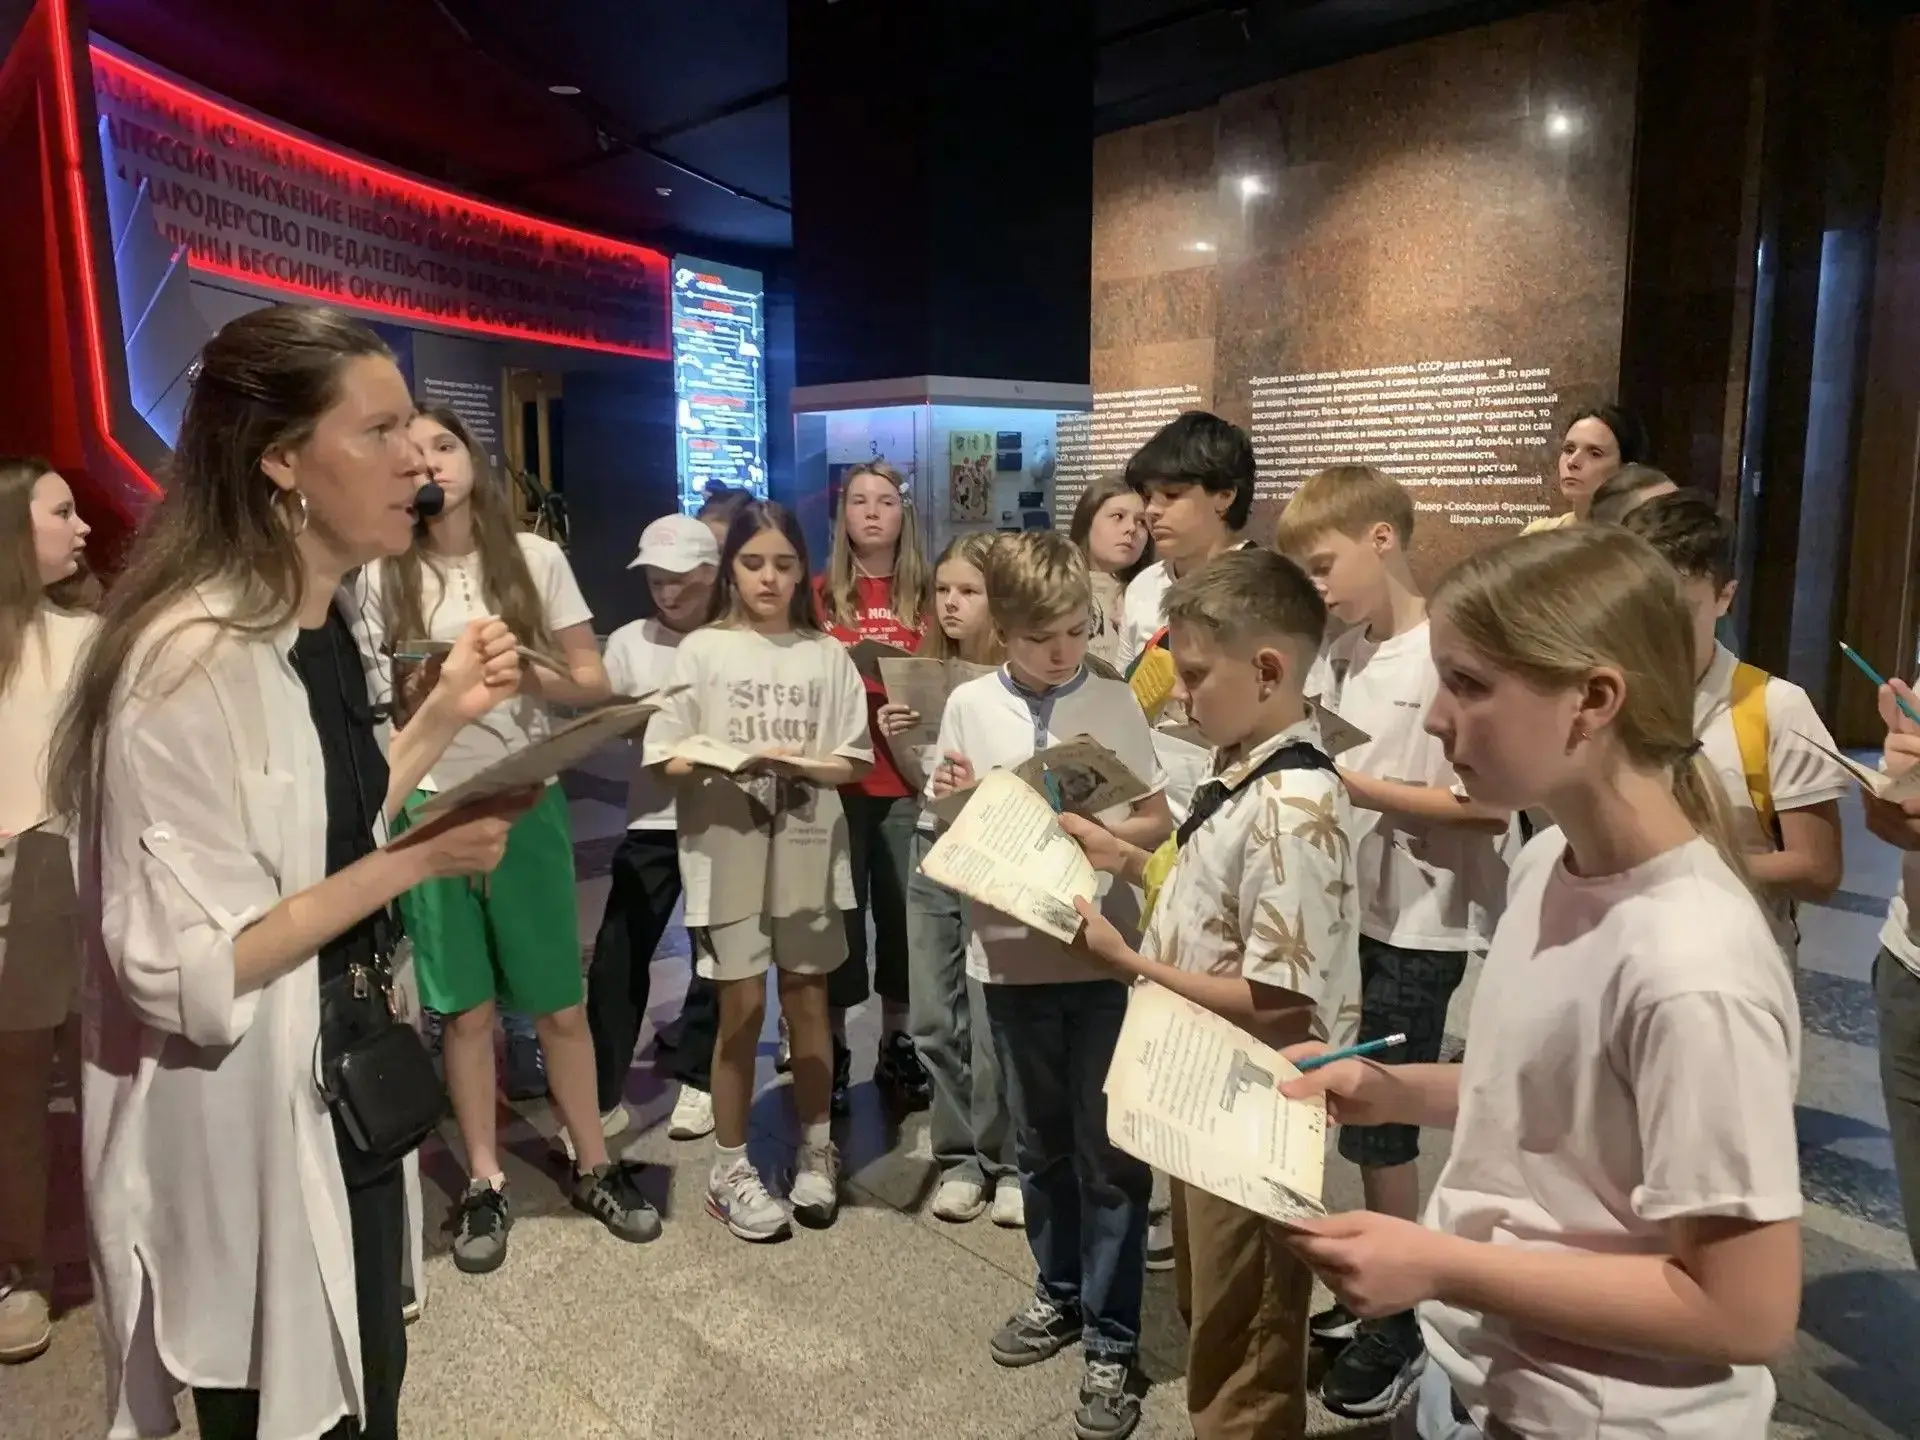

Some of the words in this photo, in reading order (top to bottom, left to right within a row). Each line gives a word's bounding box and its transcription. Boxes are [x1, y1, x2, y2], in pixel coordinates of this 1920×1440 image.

[221, 157, 343, 225] УНИЖЕНИЕ
[135, 168, 301, 249] МАРОДЕРСТВО
[306, 225, 464, 289] ПРЕДАТЕЛЬСТВО
[238, 243, 344, 296] БЕССИЛИЕ
[1280, 374, 1294, 382] всю
[1296, 373, 1315, 381] свою
[1316, 371, 1339, 379] мощь
[1340, 368, 1369, 378] против
[1370, 365, 1416, 375] агрессора,
[1417, 360, 1442, 371] СССР
[1443, 361, 1460, 370] дал
[1461, 359, 1484, 367] всем
[1486, 357, 1511, 366] ныне
[1298, 383, 1331, 393] народам
[1332, 380, 1384, 392] уверенность
[1419, 373, 1489, 384] освобождении.
[1519, 367, 1549, 377] время
[1288, 396, 1325, 406] Германии
[1343, 393, 1378, 403] престиж
[1379, 388, 1440, 399] поколеблены,
[1442, 386, 1474, 395] солнце
[1476, 381, 1513, 394] русской
[1515, 381, 1545, 390] славы
[1321, 406, 1339, 415] Весь
[1340, 406, 1357, 415] мир
[1359, 403, 1407, 414] убеждается
[1435, 400, 1451, 408] что
[1453, 399, 1472, 407] этот
[1474, 393, 1557, 406] 175-миллионный
[1251, 423, 1273, 432] народ
[1274, 421, 1305, 431] достоин
[1307, 419, 1350, 428] называться
[1354, 417, 1392, 425] великим,
[1394, 415, 1425, 423] потому
[1426, 414, 1440, 422] что
[1443, 413, 1454, 421] он
[1456, 412, 1483, 422] умеет
[1484, 410, 1536, 420] сражаться,
[1321, 431, 1358, 439] невзгоды
[1367, 429, 1406, 437] наносить
[1408, 427, 1449, 435] ответные
[1450, 425, 1480, 435] удары,
[1483, 424, 1499, 432] так
[1532, 422, 1551, 430] сам
[1334, 443, 1352, 452] руки
[1354, 442, 1387, 451] оружие,
[1389, 439, 1454, 450] организовался
[1456, 439, 1473, 447] для
[1474, 436, 1513, 447] борьбы,
[1523, 436, 1546, 444] ведь
[1307, 455, 1350, 463] испытания
[1363, 451, 1414, 462] поколебали
[1430, 451, 1497, 459] сплоченности.
[1255, 466, 1299, 478] ранцузский
[1437, 465, 1467, 474] успехи
[1477, 464, 1498, 473] рост
[1430, 475, 1472, 486] Францию
[1492, 475, 1542, 484] желанной
[1414, 501, 1441, 511] Лидер
[1444, 501, 1499, 511] «Свободной
[1501, 501, 1550, 512] Франции»
[1450, 513, 1480, 524] Шарль
[1481, 516, 1494, 524] де
[1495, 514, 1523, 525] Голль,
